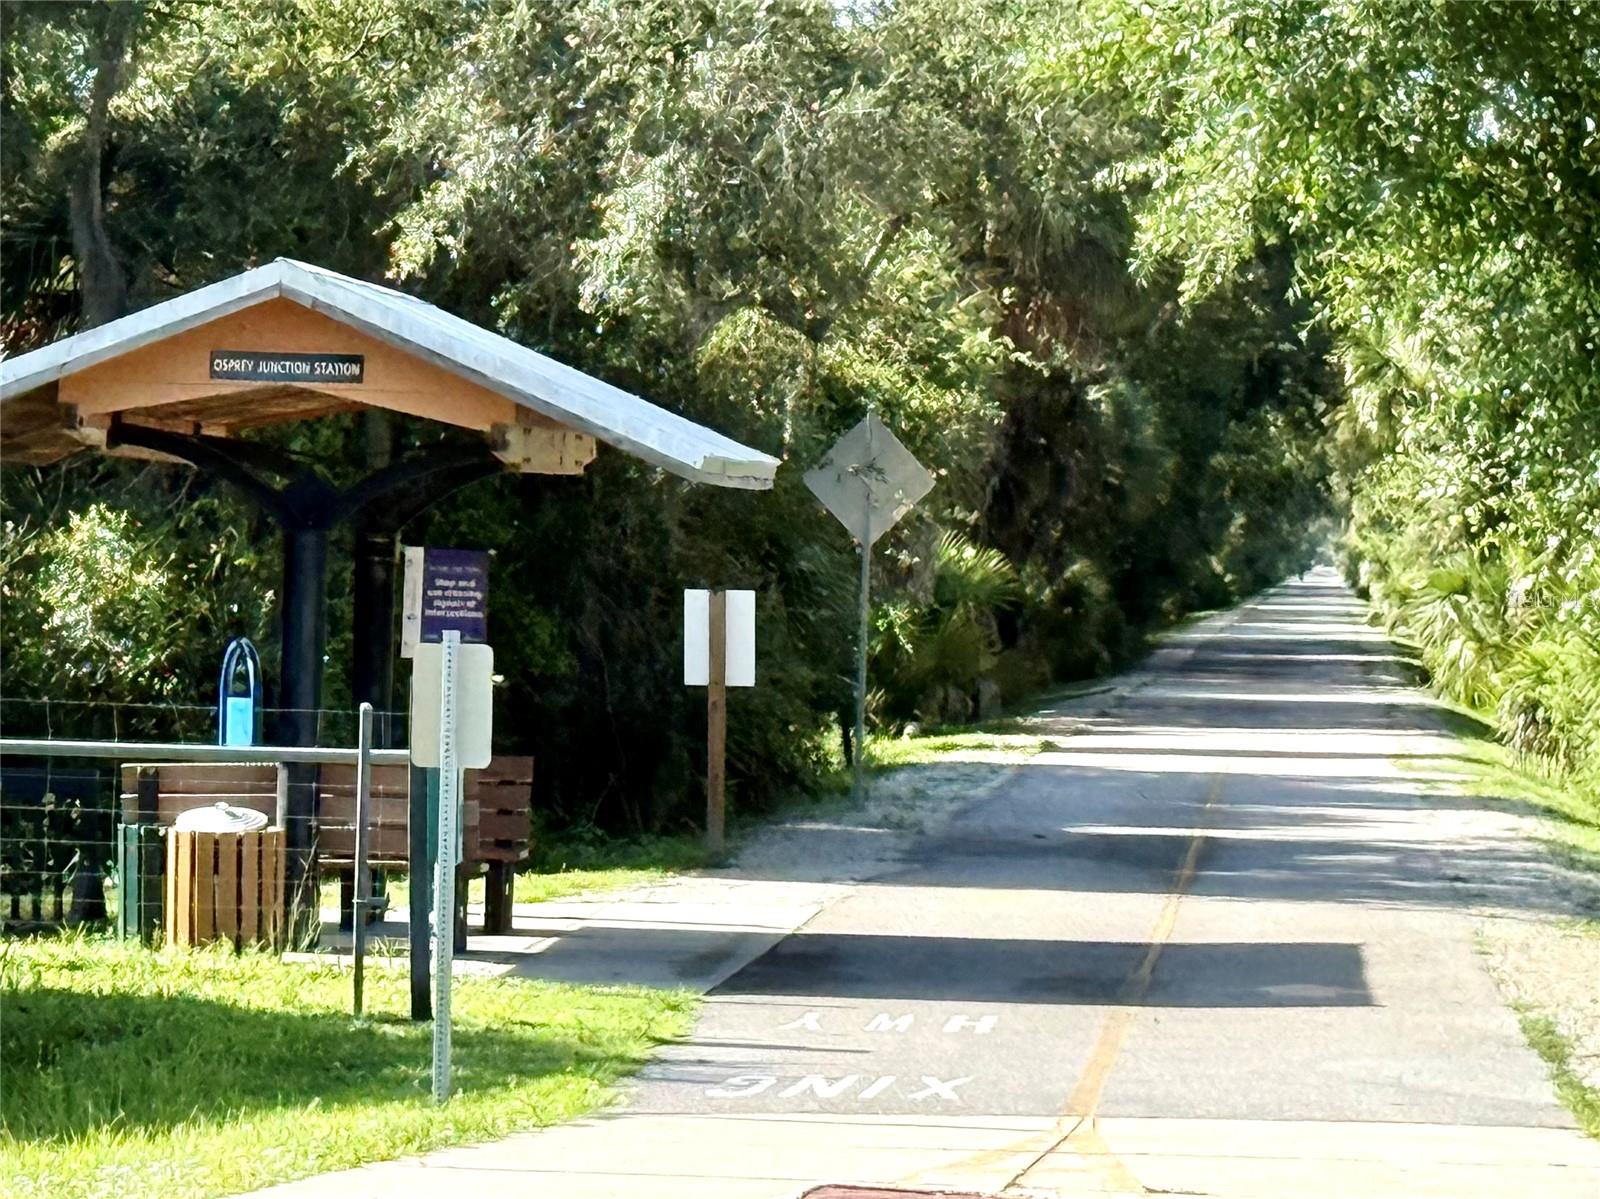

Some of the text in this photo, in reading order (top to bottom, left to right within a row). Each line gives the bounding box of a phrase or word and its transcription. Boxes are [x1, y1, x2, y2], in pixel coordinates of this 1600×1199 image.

[213, 358, 361, 376] OSPREY JUNCTION STATION
[705, 1074, 974, 1101] XING
